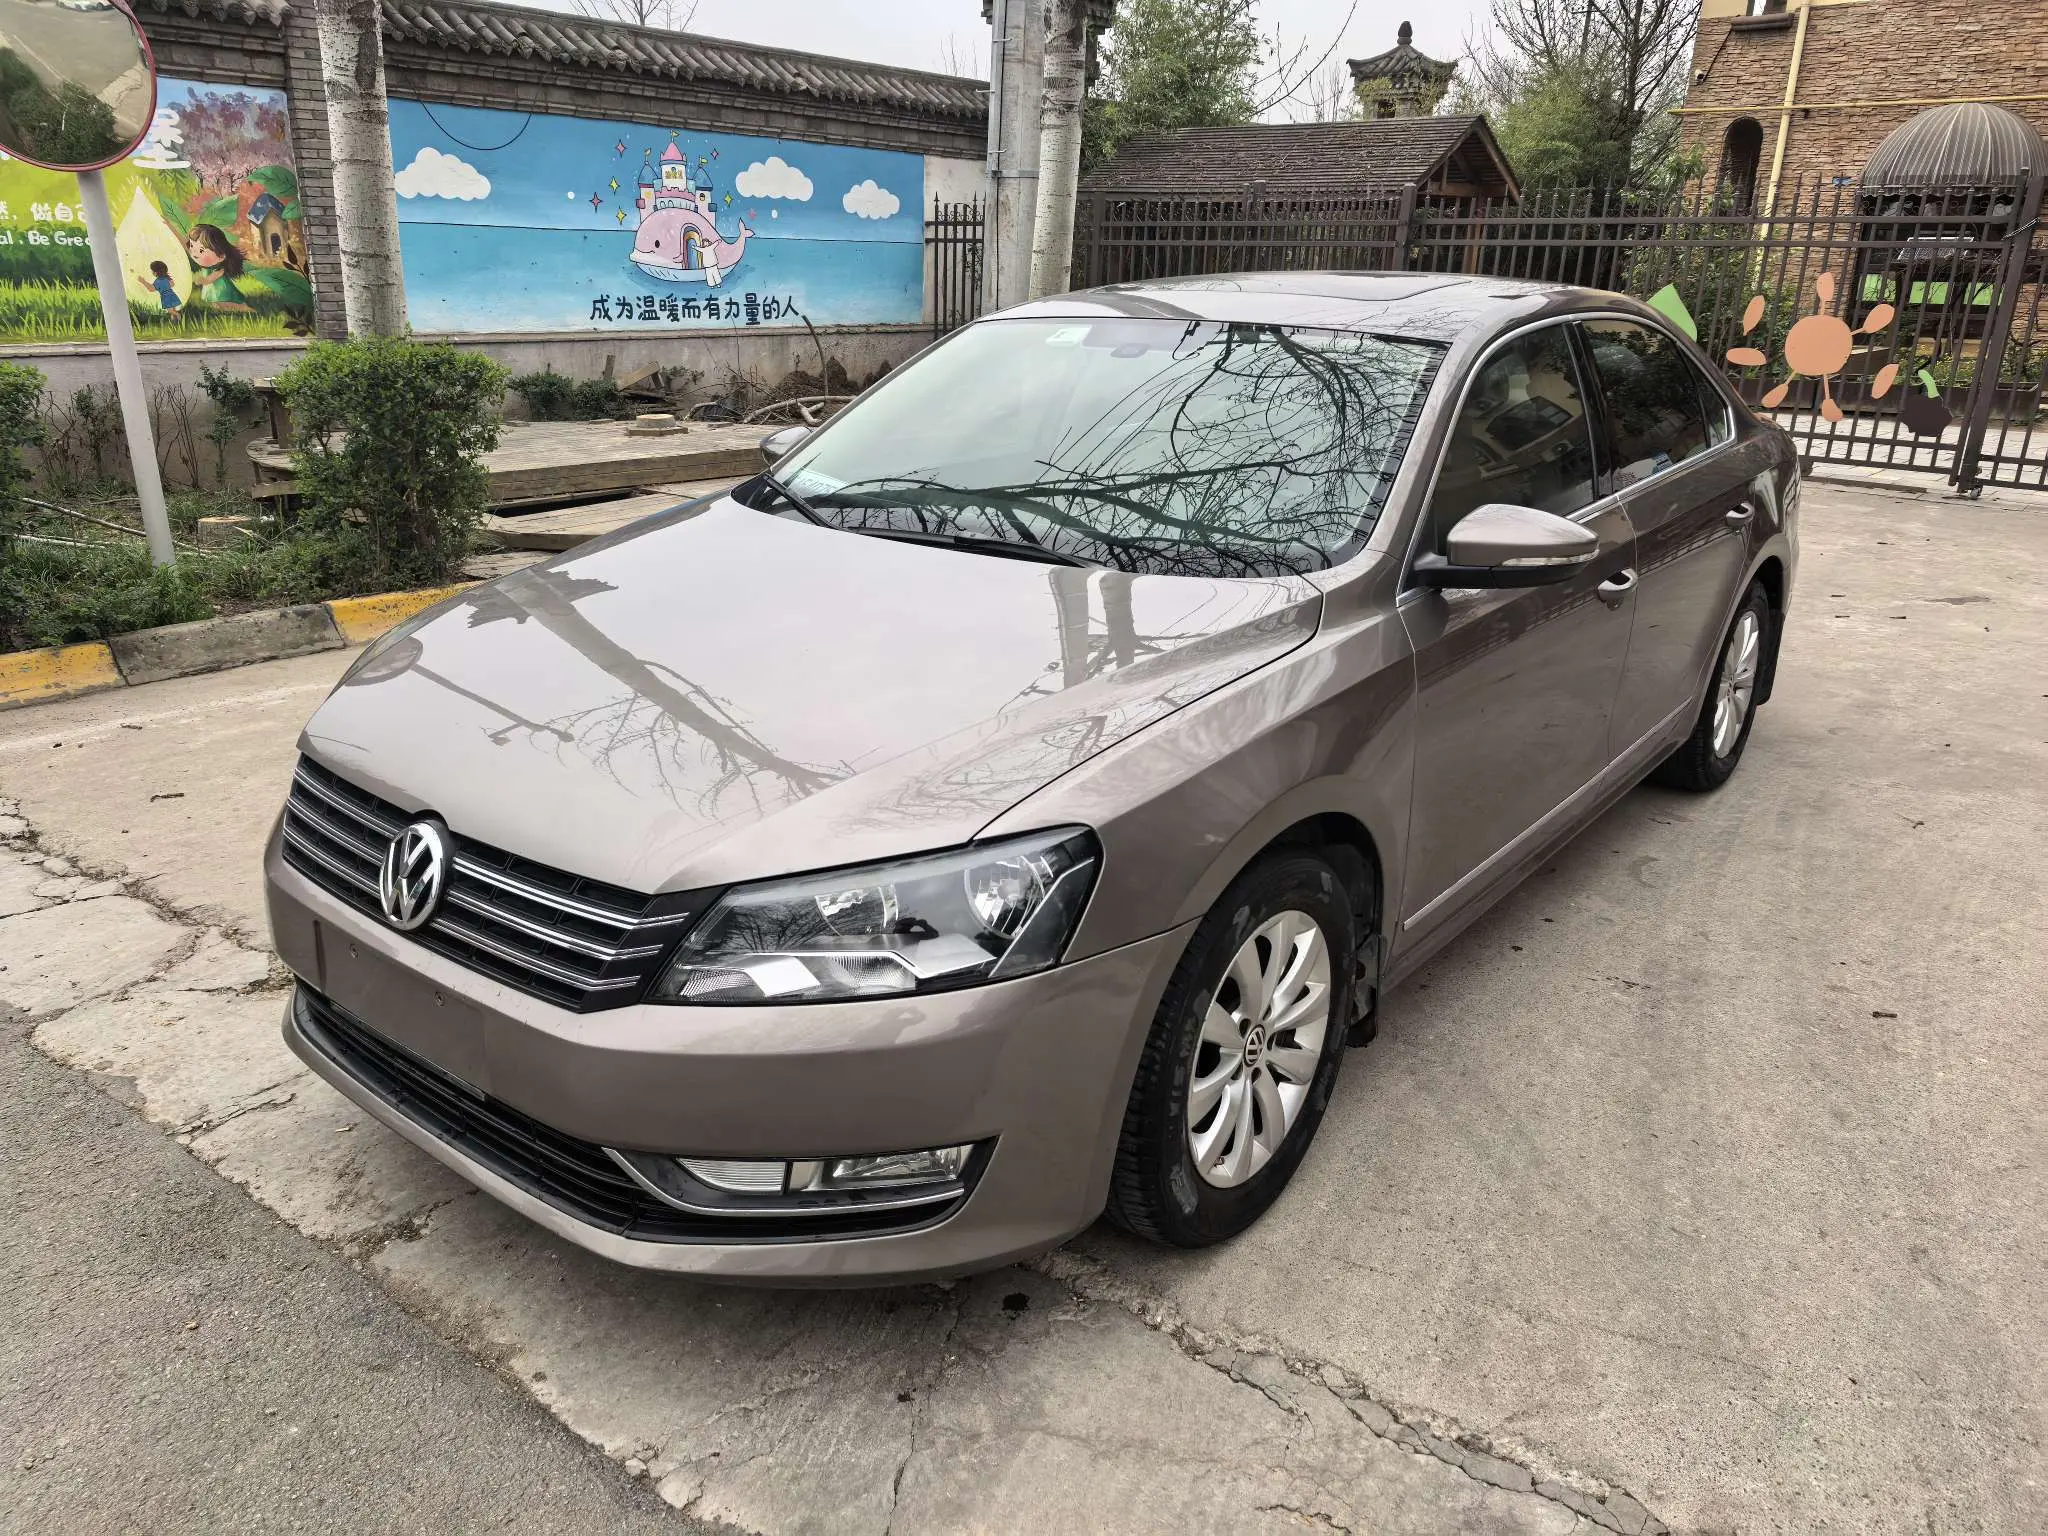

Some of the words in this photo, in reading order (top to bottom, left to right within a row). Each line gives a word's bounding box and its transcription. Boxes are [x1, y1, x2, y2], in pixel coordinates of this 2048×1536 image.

[27, 230, 50, 246] Be
[589, 292, 800, 326] 成为温暖而有力量的人
